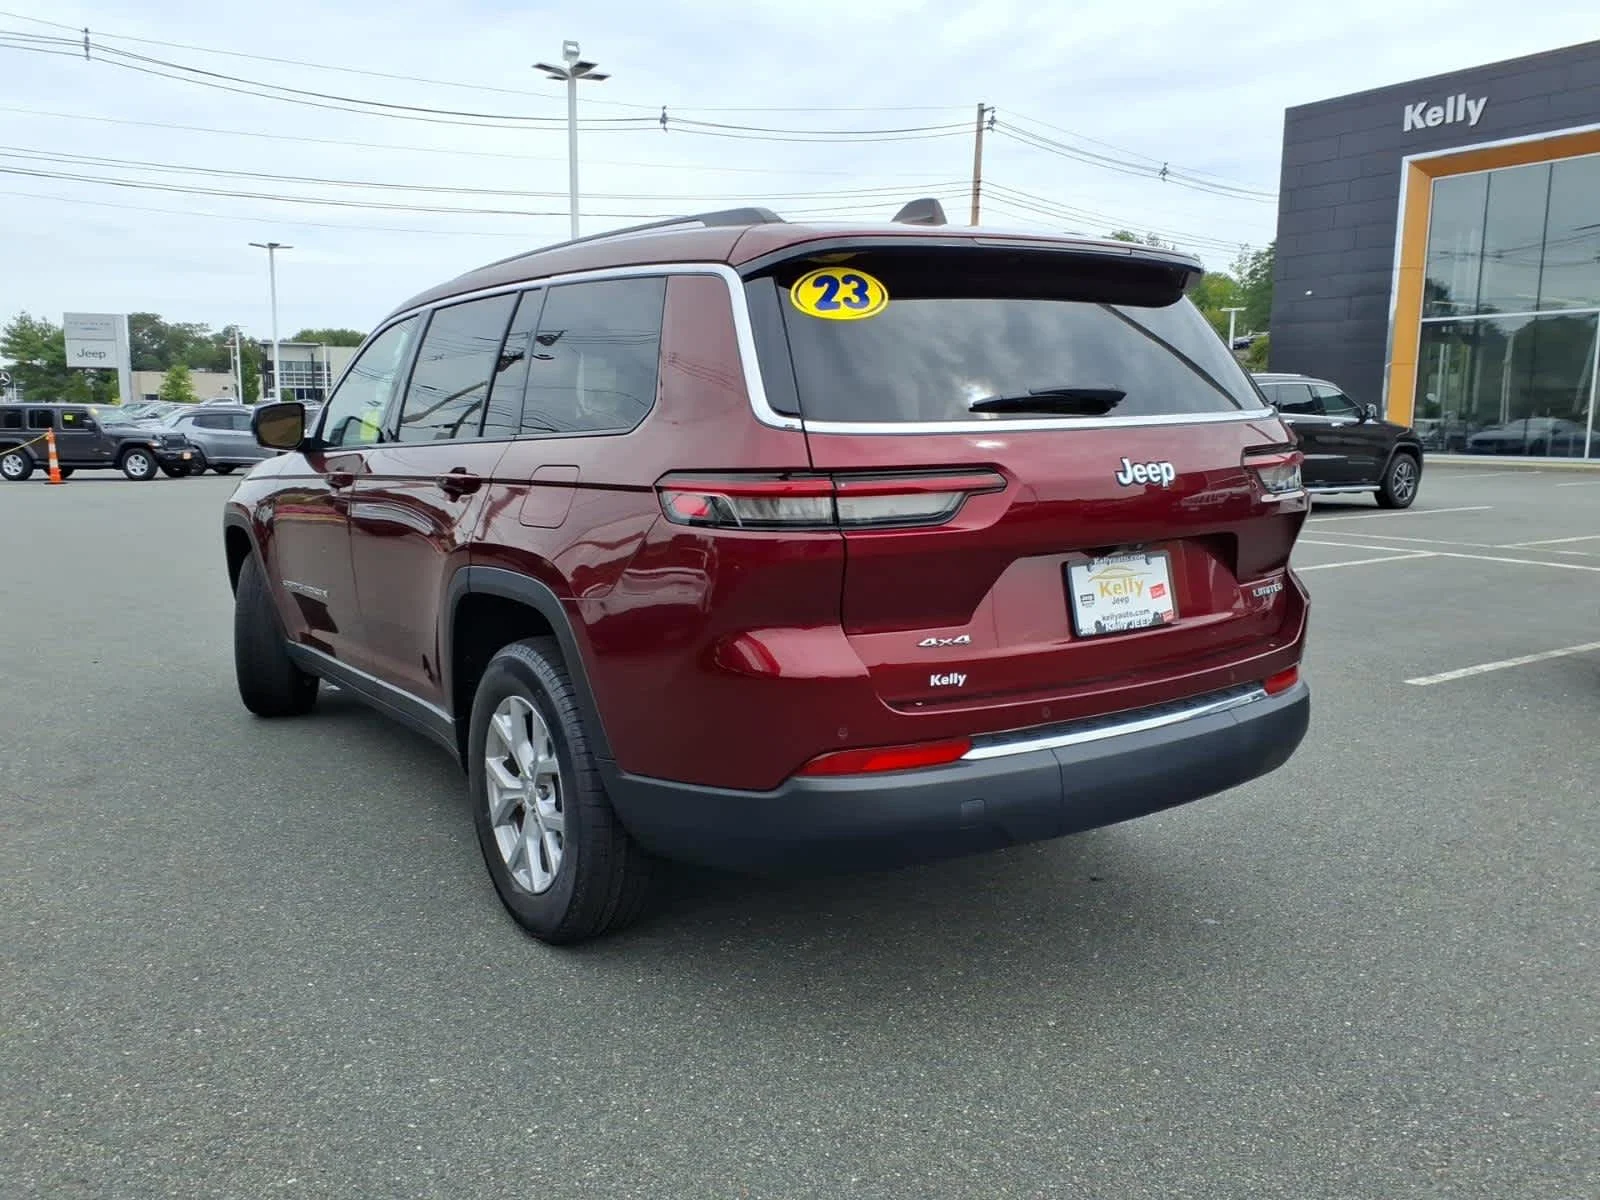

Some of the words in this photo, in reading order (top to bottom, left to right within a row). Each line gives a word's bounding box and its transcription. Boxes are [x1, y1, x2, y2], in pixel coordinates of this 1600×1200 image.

[1403, 93, 1488, 131] Kelly
[812, 274, 870, 311] 23
[76, 348, 106, 360] Jeep
[1115, 457, 1175, 487] Jeep
[1099, 577, 1145, 598] Kelly
[1111, 596, 1130, 605] Jeep
[917, 634, 971, 648] 4x4
[929, 672, 968, 688] Kelly
